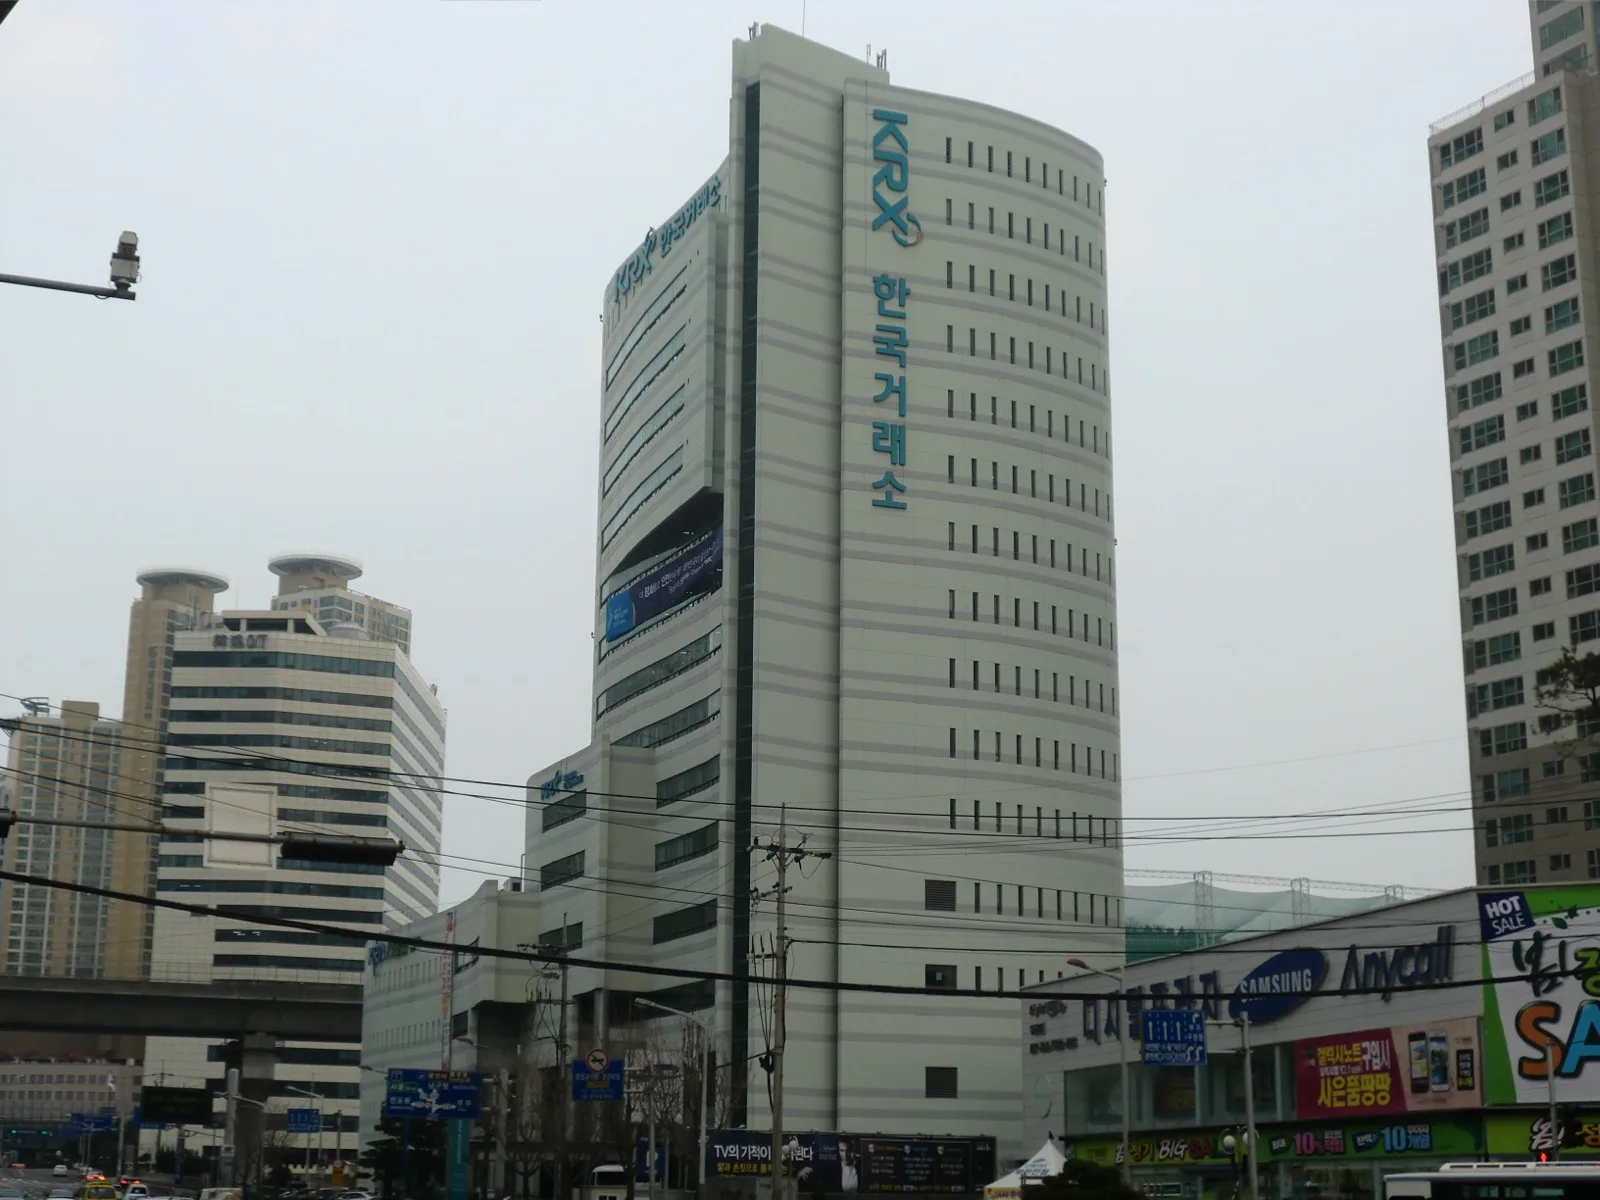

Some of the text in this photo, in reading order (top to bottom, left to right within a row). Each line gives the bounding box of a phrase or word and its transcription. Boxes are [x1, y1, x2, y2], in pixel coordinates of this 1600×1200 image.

[872, 108, 911, 235] KRX
[615, 236, 655, 303] KRX
[872, 273, 911, 511] 한국거래소
[1484, 895, 1521, 920] HOT
[1491, 912, 1527, 936] SALE
[1341, 925, 1457, 1003] Anycall
[1239, 968, 1313, 1005] SAMSUNG
[713, 1144, 740, 1161] TV의
[740, 1144, 772, 1162] 기적이
[1158, 1139, 1189, 1161] BIG
[1380, 1125, 1407, 1152] 10
